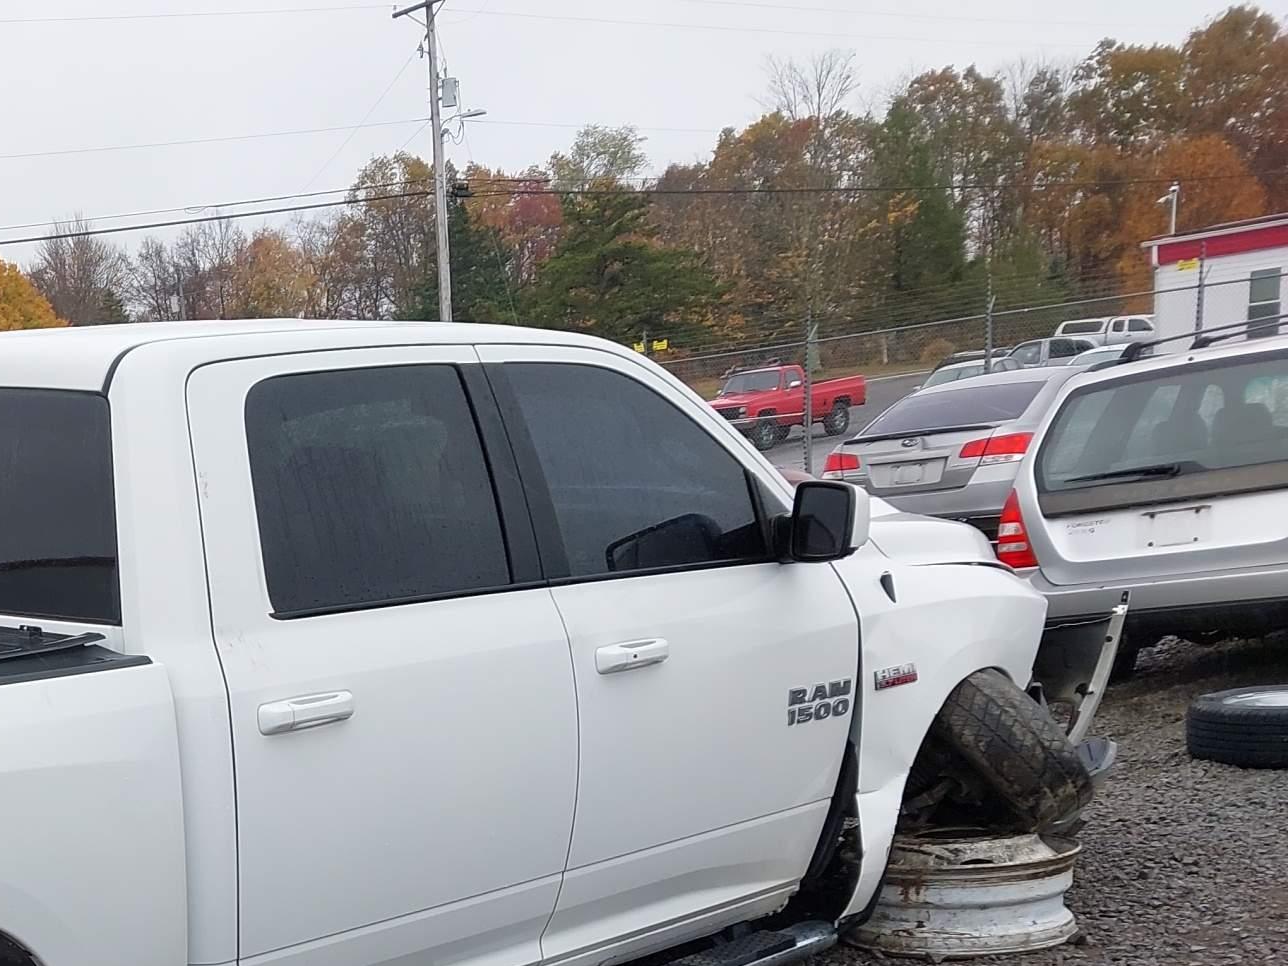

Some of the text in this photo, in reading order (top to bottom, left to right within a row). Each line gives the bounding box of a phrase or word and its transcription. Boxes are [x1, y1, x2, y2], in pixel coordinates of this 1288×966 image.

[876, 662, 918, 681] HEMI
[788, 679, 852, 707] RAM
[787, 698, 850, 727] 1500
